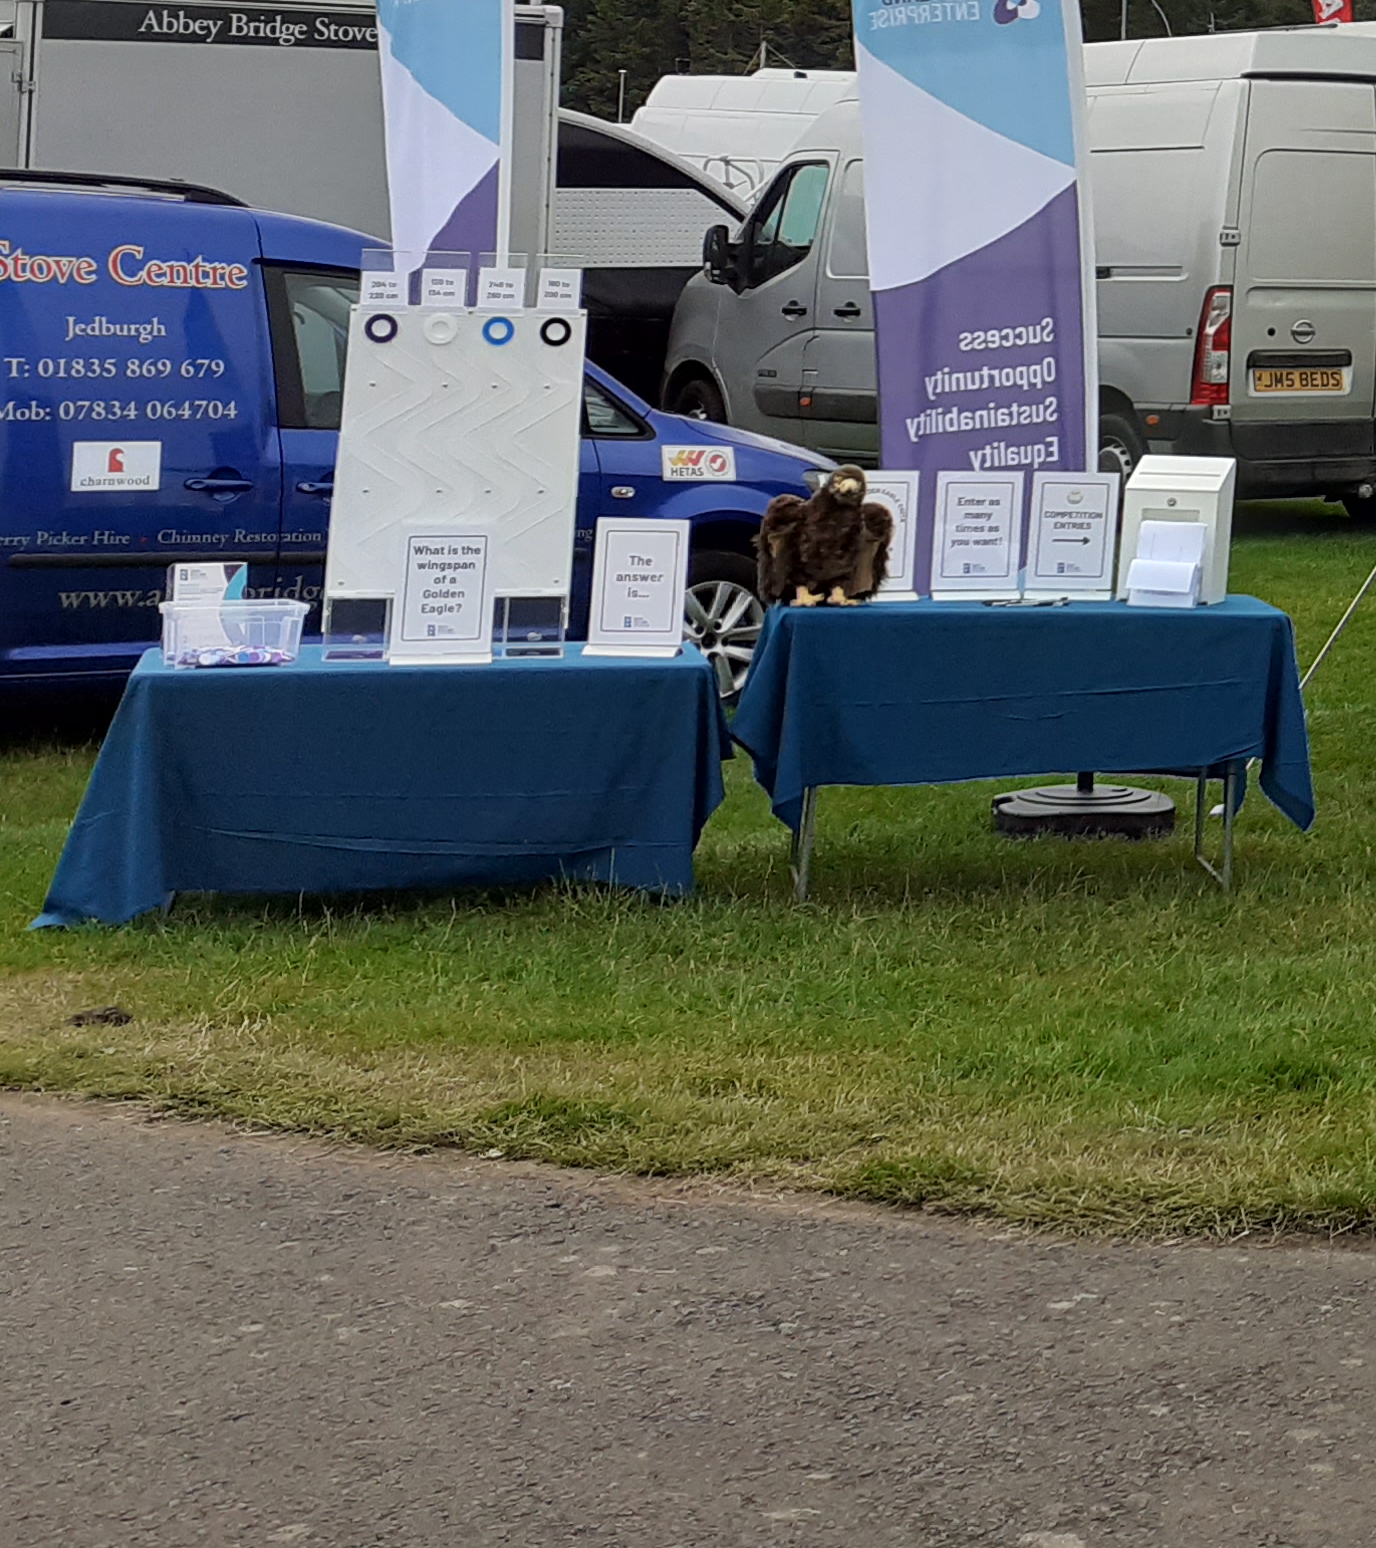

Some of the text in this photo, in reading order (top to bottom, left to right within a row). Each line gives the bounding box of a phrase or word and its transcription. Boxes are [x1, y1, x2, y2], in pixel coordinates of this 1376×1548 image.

[138, 9, 378, 46] Abbey Bridge Stove
[107, 244, 248, 290] Centre
[65, 316, 167, 344] Jedburgh
[3, 357, 225, 379] T: 01835 869 679
[58, 399, 138, 420] 07834
[146, 400, 239, 421] 064704
[670, 467, 705, 478] HETAS
[80, 475, 151, 487] charnwood
[957, 497, 986, 507] Enter
[963, 512, 993, 522] many
[1044, 511, 1103, 520] COMPETITION
[955, 525, 985, 533] times
[1053, 521, 1092, 530] ENTRIES
[36, 531, 89, 546] Picker
[92, 530, 131, 545] Hire
[157, 529, 230, 548] Chimney
[950, 539, 970, 549] you
[413, 545, 481, 556] What is the
[417, 559, 476, 572] wingspan
[629, 556, 653, 566] The
[433, 574, 457, 585] of a
[615, 572, 664, 583] answer
[422, 588, 465, 600] Golden
[421, 603, 462, 616] Eagle?
